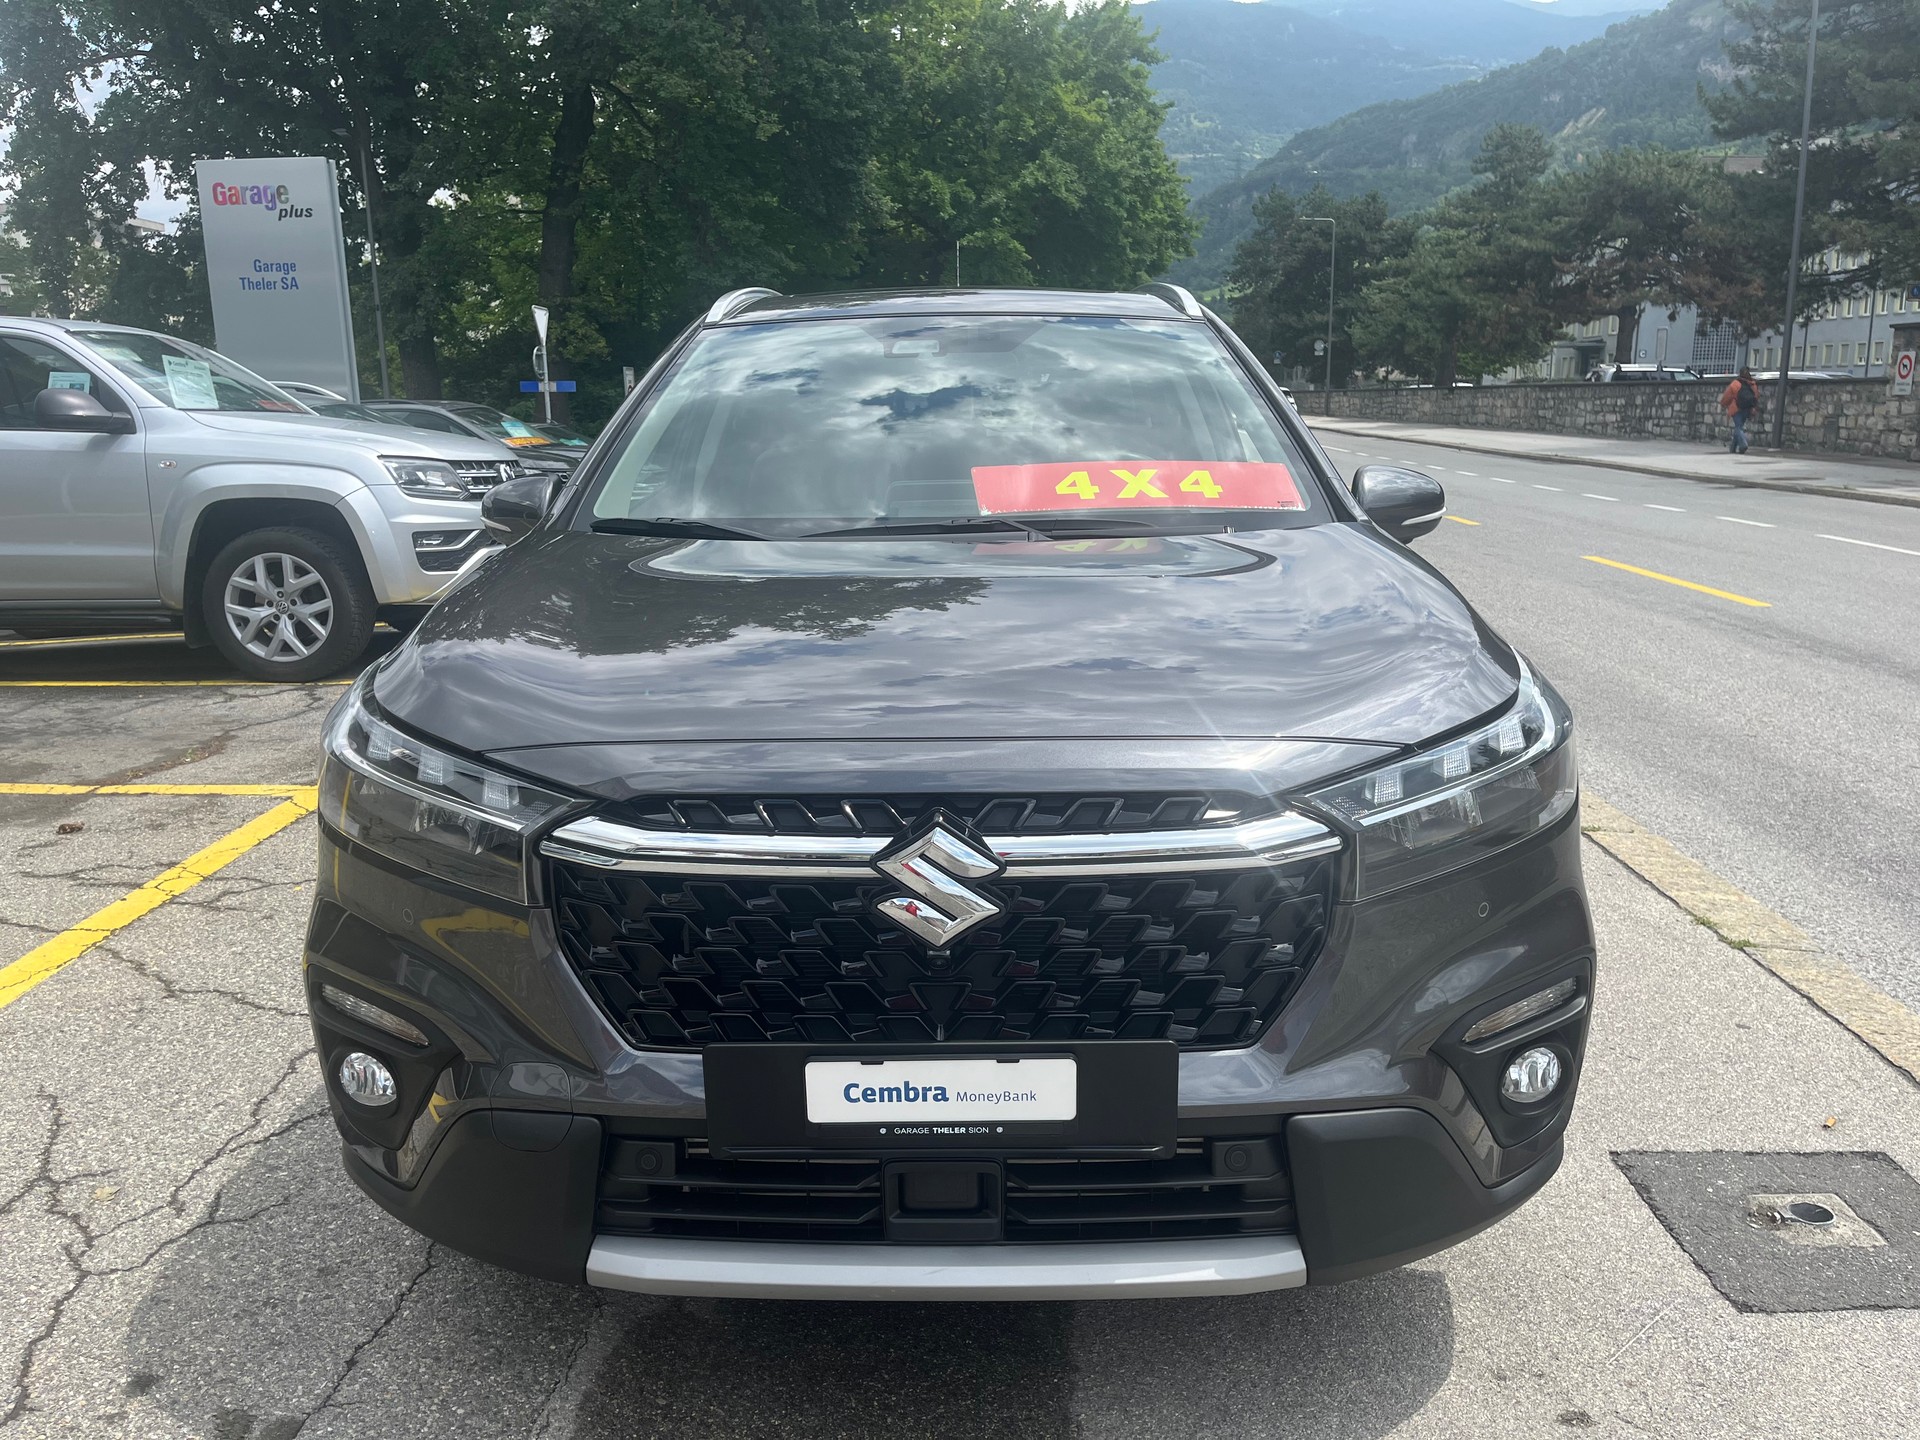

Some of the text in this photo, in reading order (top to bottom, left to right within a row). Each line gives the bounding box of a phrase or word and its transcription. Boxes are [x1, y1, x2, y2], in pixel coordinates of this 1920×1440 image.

[212, 182, 289, 211] Garage
[278, 204, 313, 221] plus
[253, 259, 297, 275] Garage
[239, 277, 299, 291] Theler SA
[843, 1080, 1037, 1105] Cembra MoneyBank
[968, 1126, 989, 1134] SION
